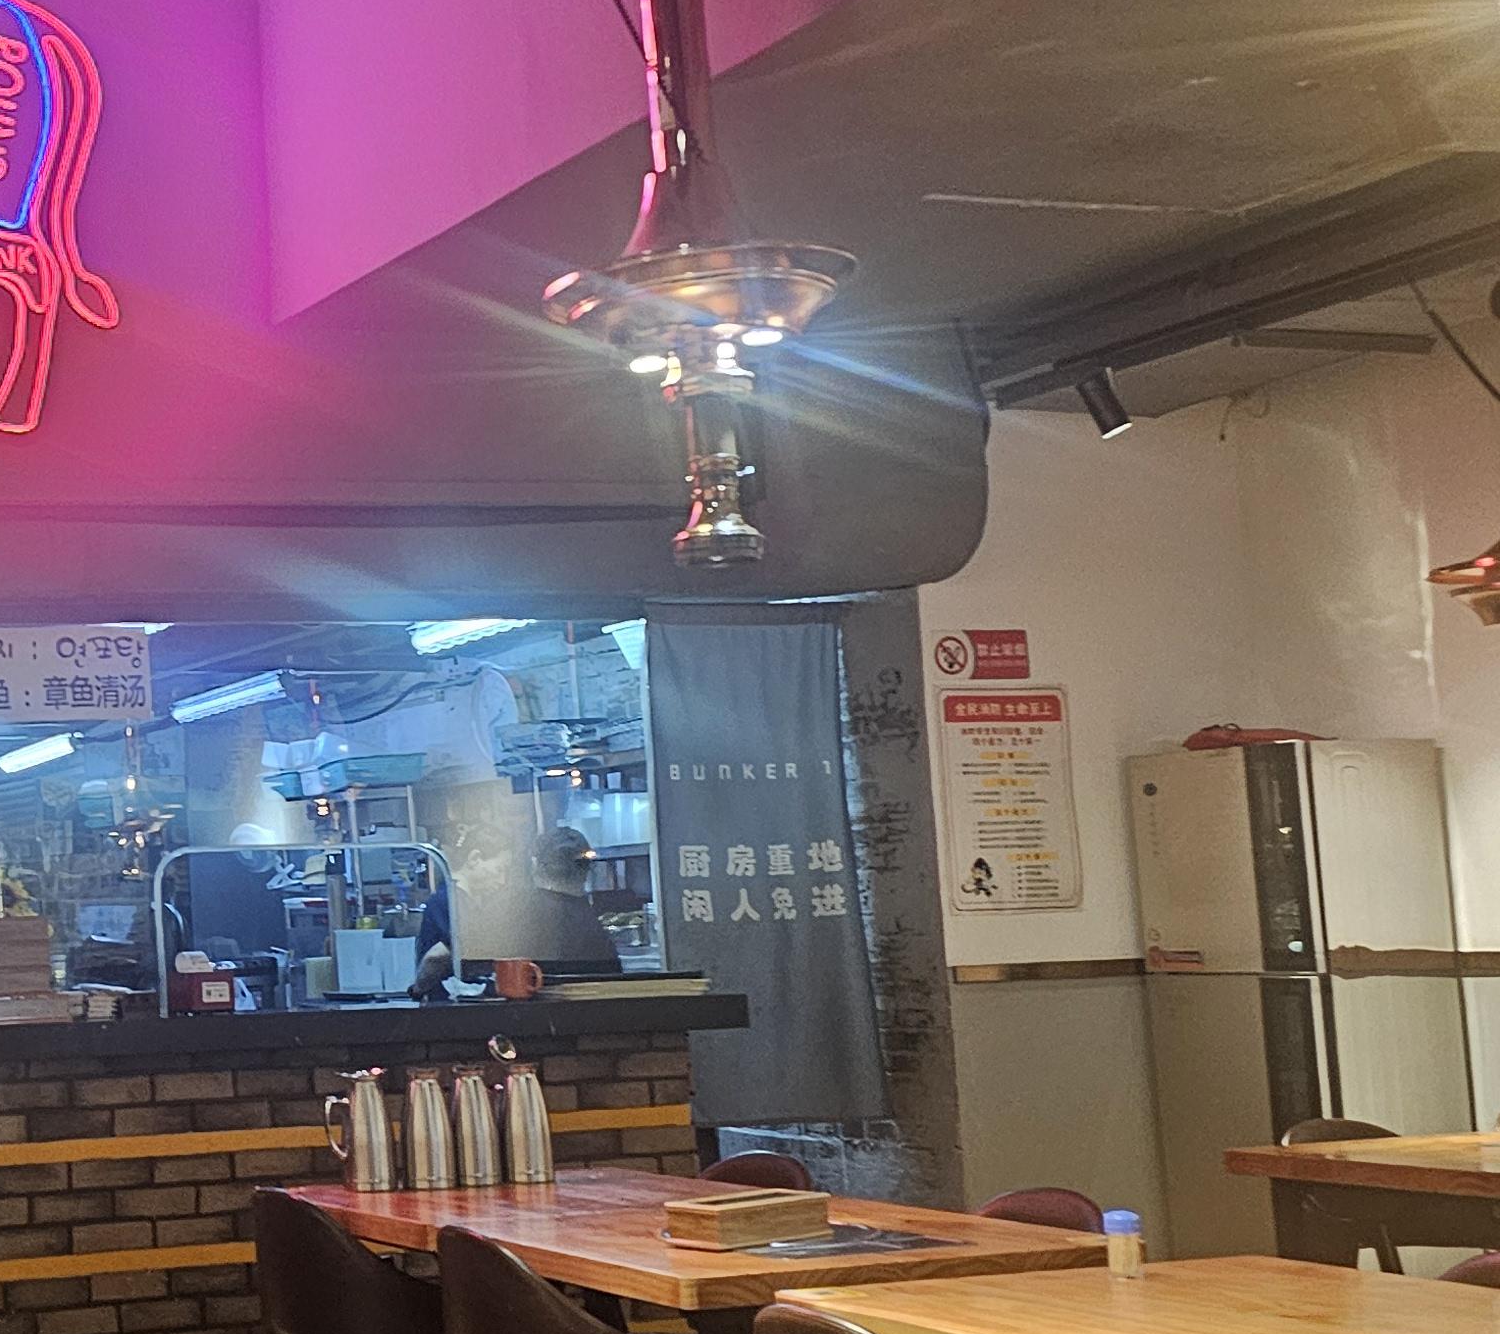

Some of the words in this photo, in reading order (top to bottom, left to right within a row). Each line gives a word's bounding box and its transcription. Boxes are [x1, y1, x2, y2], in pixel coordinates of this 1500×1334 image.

[55, 636, 146, 669] 연포탕
[678, 839, 845, 878] 厨房重地
[681, 882, 848, 923] 闲人免进
